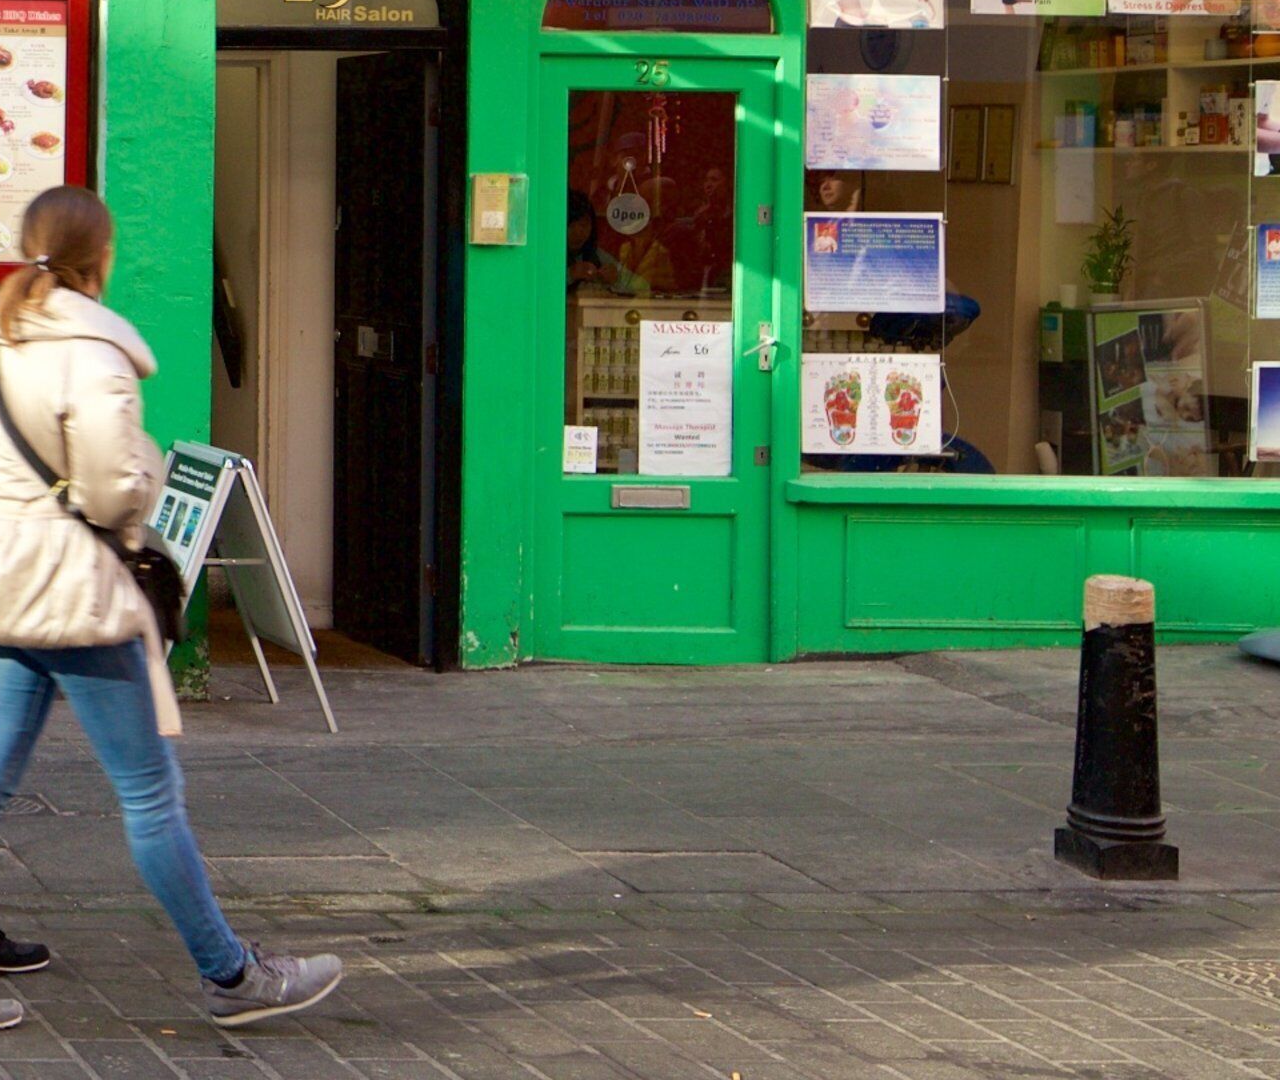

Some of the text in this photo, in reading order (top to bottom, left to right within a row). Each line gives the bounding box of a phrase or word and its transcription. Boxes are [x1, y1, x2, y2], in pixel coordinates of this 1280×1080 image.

[1122, 0, 1153, 11] Stress
[1154, 1, 1163, 11] &
[315, 5, 414, 22] HAIR Salon
[634, 58, 672, 87] 25
[611, 207, 646, 224] Open
[653, 323, 721, 335] MASSAGE
[693, 343, 709, 356] £6
[673, 433, 701, 441] Wanted
